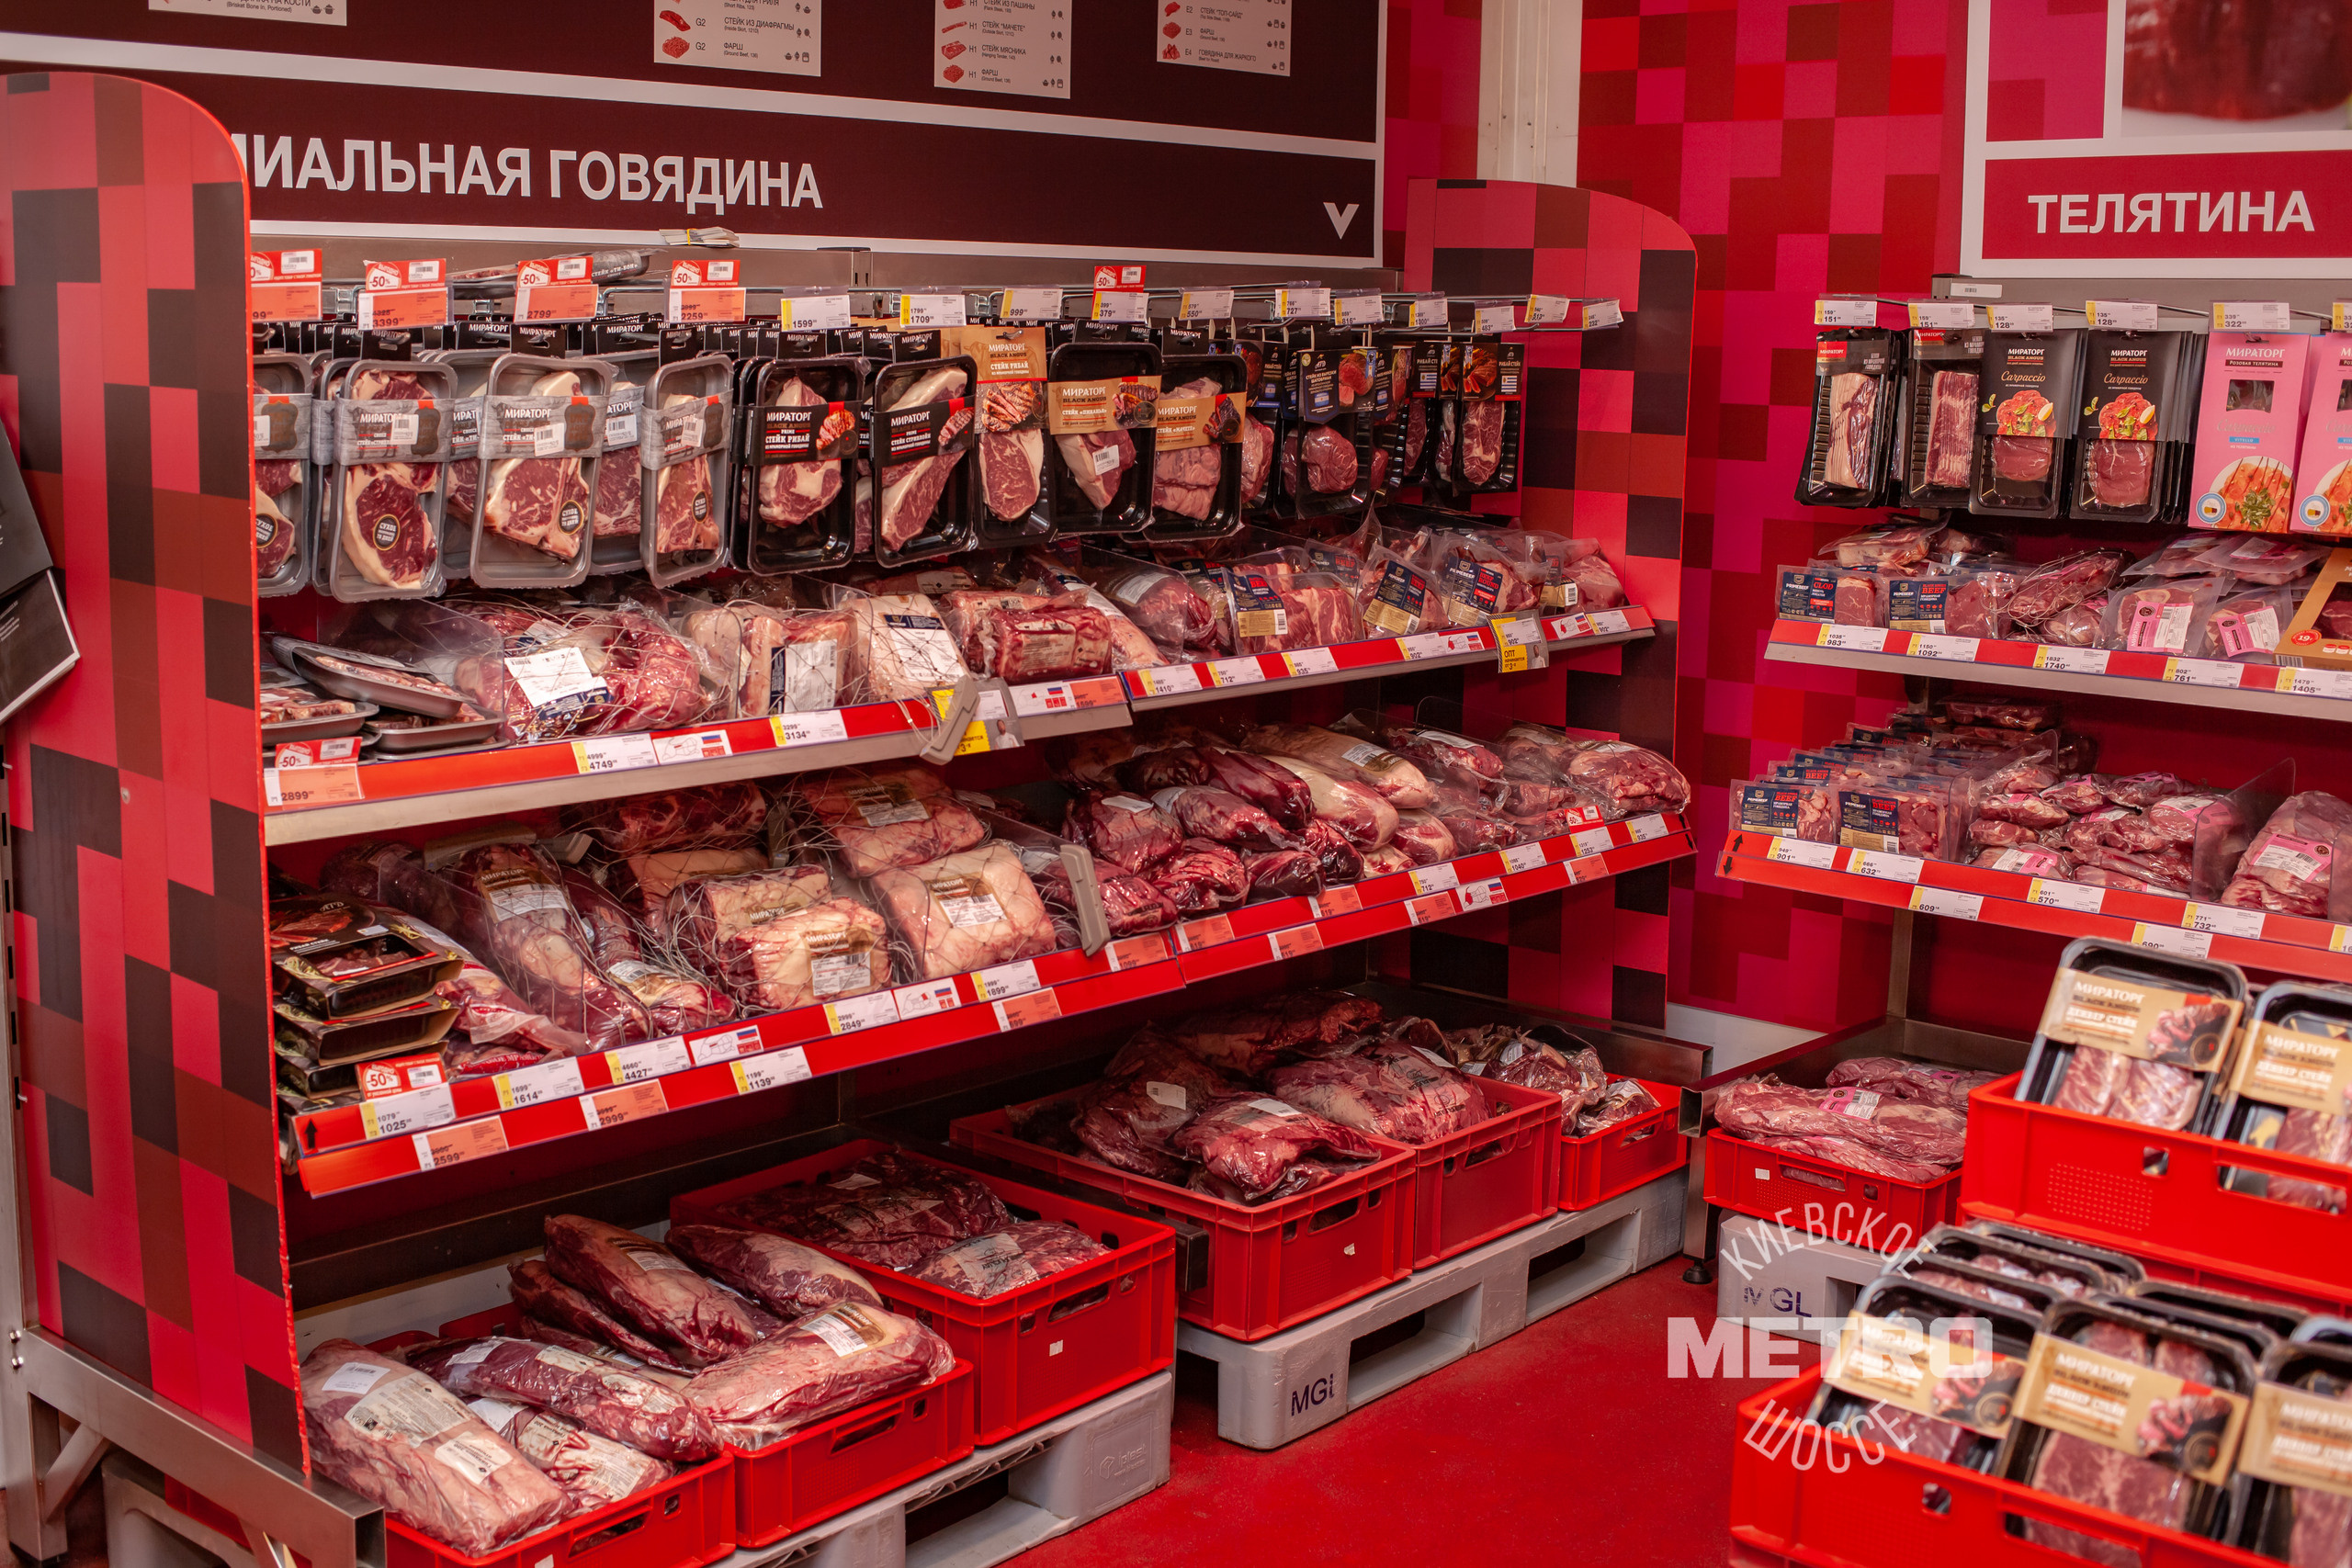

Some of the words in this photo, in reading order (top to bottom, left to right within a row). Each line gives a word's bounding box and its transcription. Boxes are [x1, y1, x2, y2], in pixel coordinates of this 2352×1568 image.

[1011, 2, 1035, 10] ПАШИНЫ
[724, 17, 744, 26] СТЕЙК
[755, 20, 794, 30] ДИАФРАГМЫ
[1001, 23, 1025, 31] "МАЧЕТЕ"
[724, 42, 743, 51] ФАРШ
[982, 44, 1000, 53] СТЕЙК
[1001, 46, 1026, 55] МЯСНИКА
[1199, 50, 1223, 58] ГОВЯДИНА
[549, 149, 823, 215] ГОВЯДИНА
[2028, 191, 2315, 233] ТЕЛЯТИНА
[606, 324, 644, 333] МИРАТОРГ
[989, 344, 1025, 352] МИРАТОРГ
[2007, 348, 2045, 356] МИРАТОРГ
[2225, 347, 2286, 358] МИРАТОРГ
[990, 362, 1009, 370] СТЕЙК
[1011, 361, 1028, 369] РИБАЙ
[2000, 370, 2046, 383] Carpaccio
[2104, 373, 2148, 385] Carpaccio
[1062, 387, 1106, 396] МИРАТОРГ
[504, 409, 551, 418] МИРАТОРГ
[1158, 406, 1197, 414] МИРАТОРГ
[767, 412, 811, 422] МИРАТОРГ
[891, 412, 930, 426] МИРАТОРГ
[2216, 419, 2276, 434] Carpaccio
[765, 435, 786, 444] СТЕЙК
[788, 434, 809, 443] РИБАЙ
[1872, 803, 1896, 811] BEEF
[806, 932, 846, 943] МИРАТОРГ
[2074, 981, 2145, 1003] МИРАТОРГ
[2265, 1033, 2341, 1058] МИРАТОРГ
